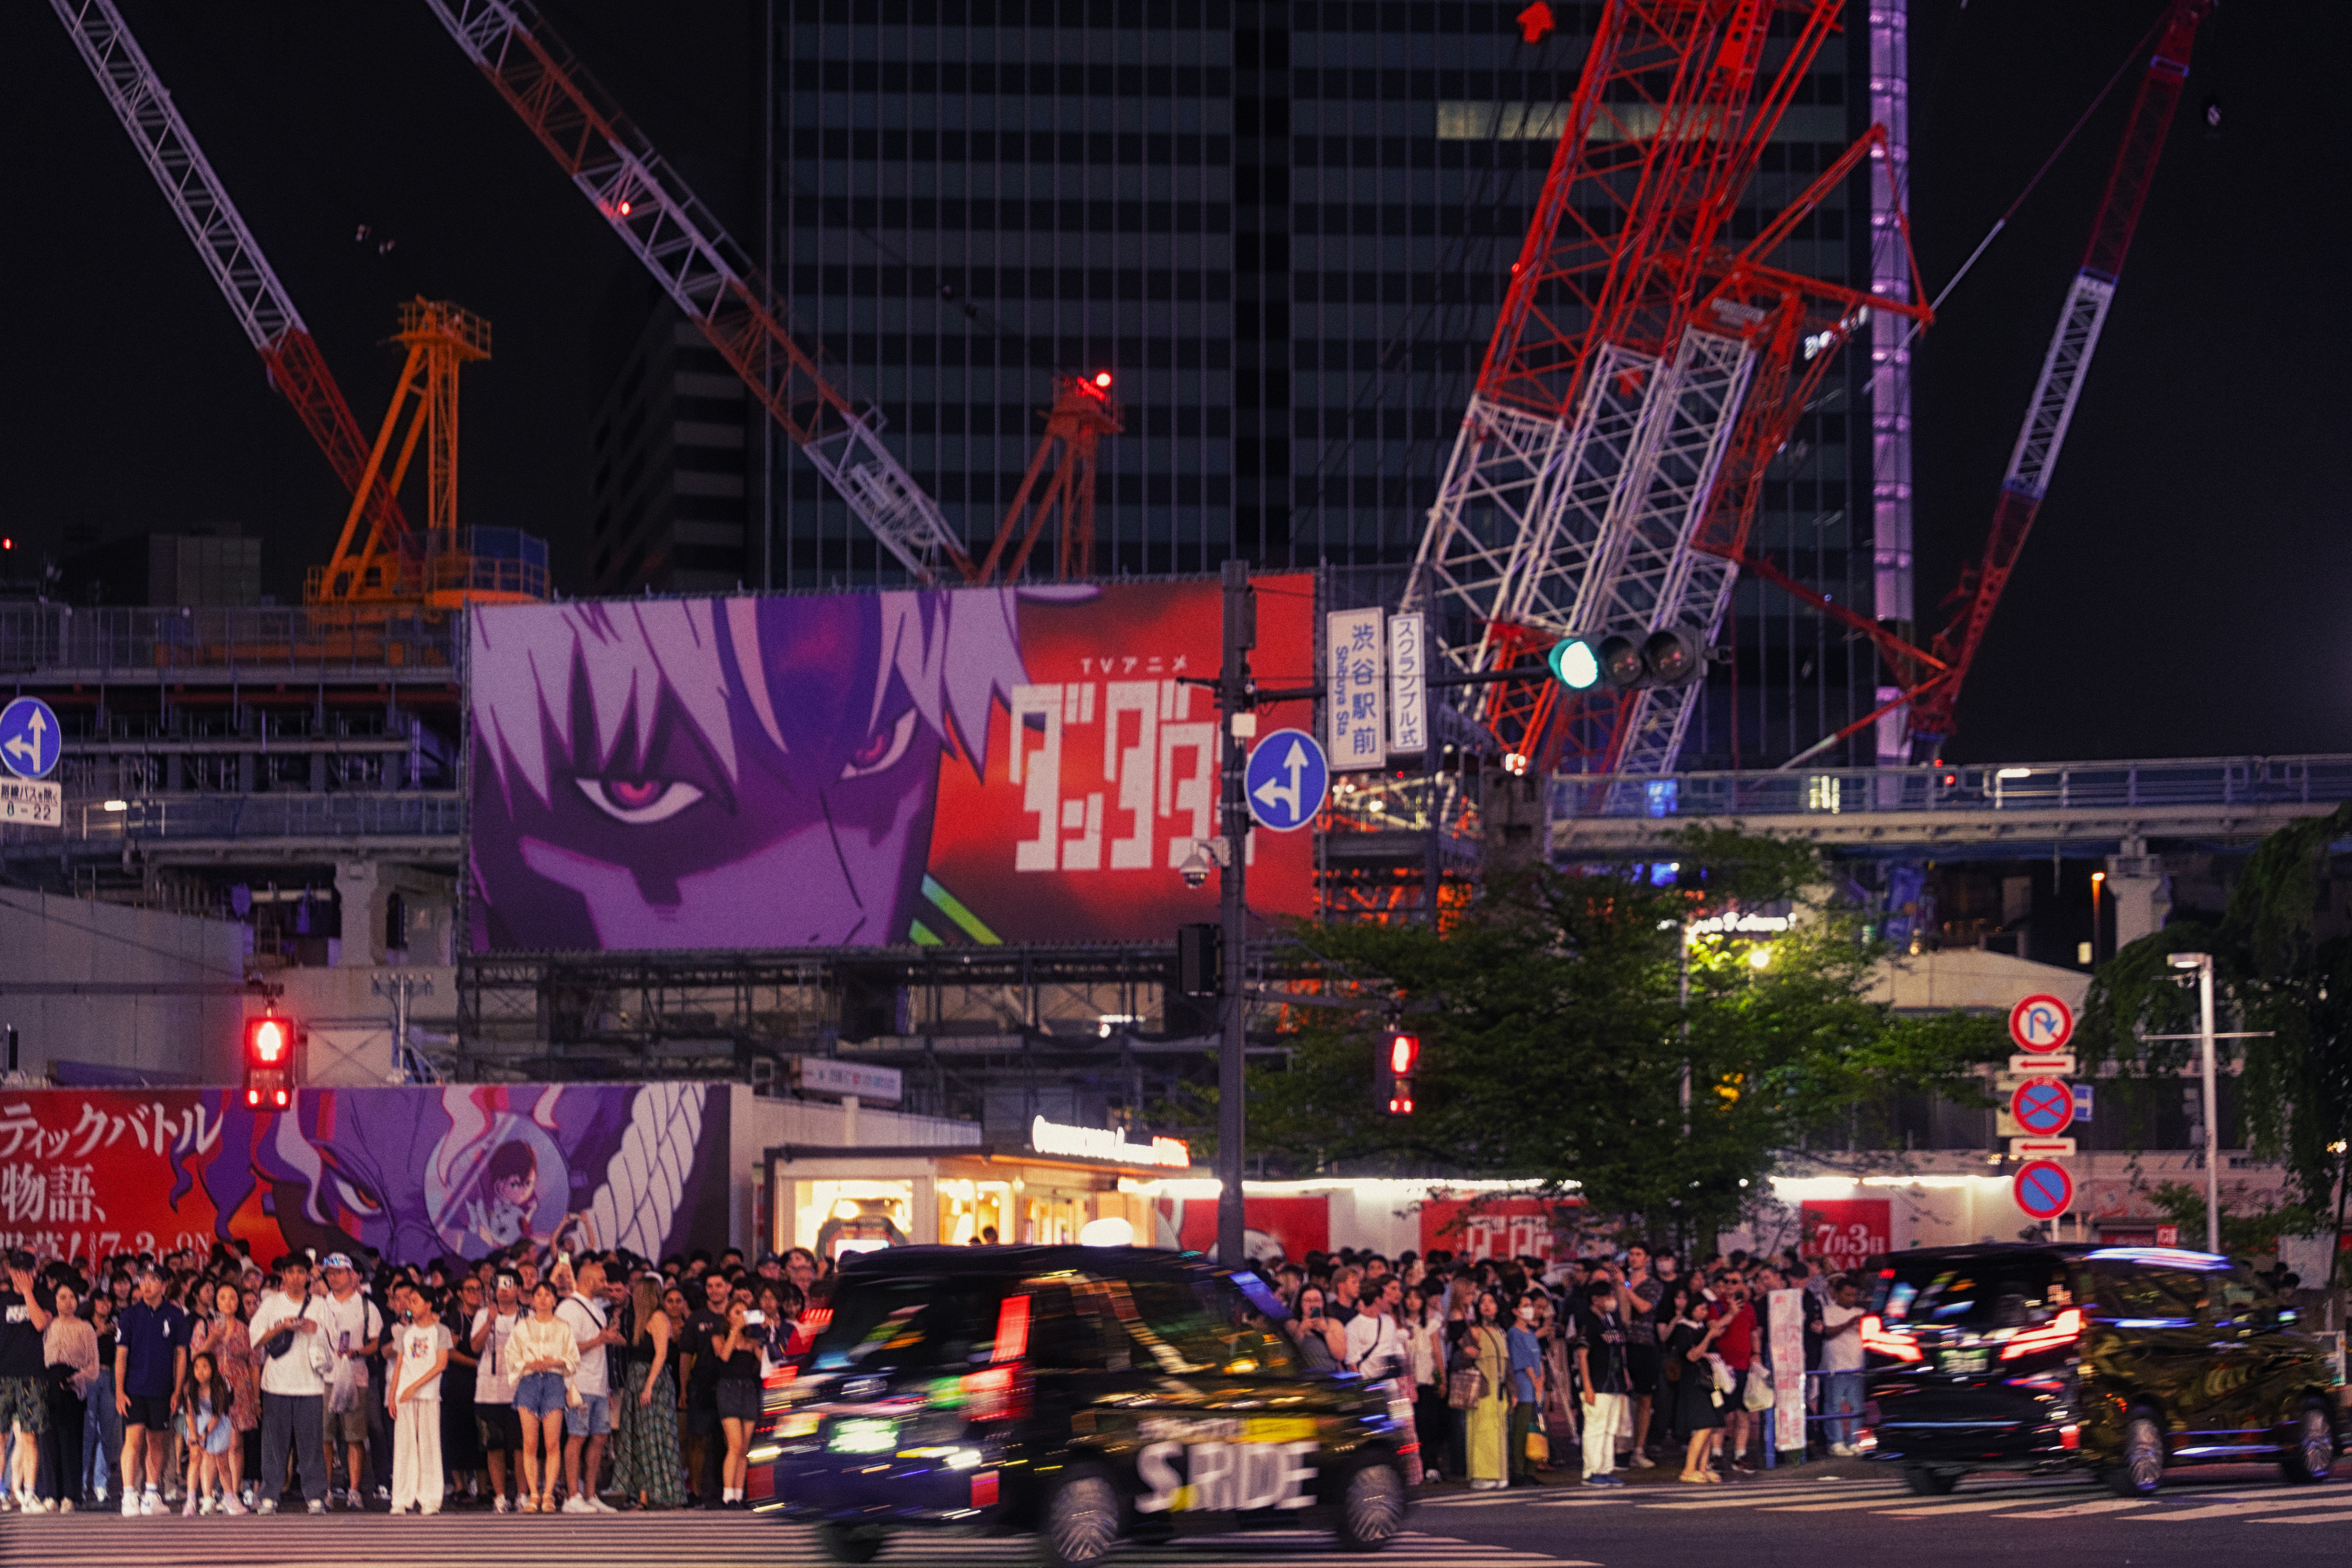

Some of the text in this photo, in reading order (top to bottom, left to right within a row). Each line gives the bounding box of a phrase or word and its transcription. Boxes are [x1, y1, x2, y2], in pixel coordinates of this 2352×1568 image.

[1080, 654, 1187, 675] TVアニメ
[1335, 646, 1349, 706] Shibuya
[1352, 623, 1376, 754] 渋谷駅前
[1398, 621, 1418, 745] スクランブル式
